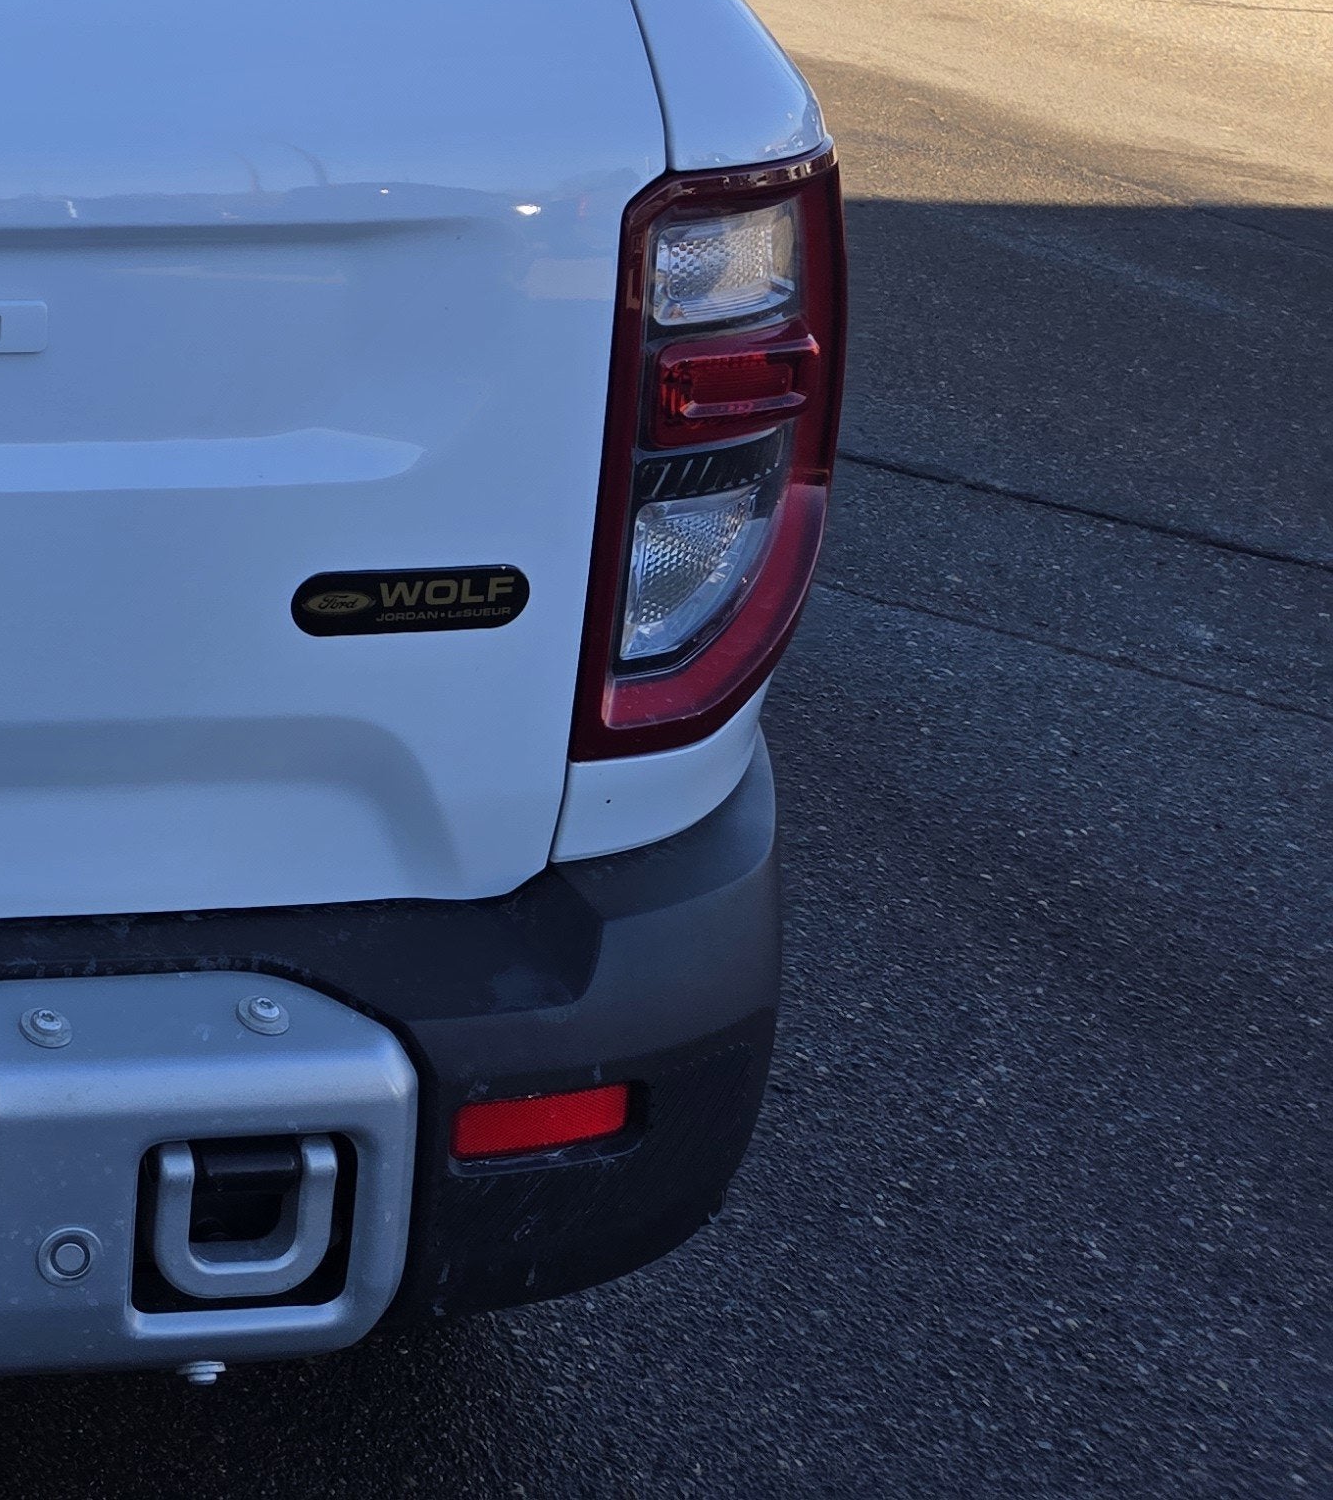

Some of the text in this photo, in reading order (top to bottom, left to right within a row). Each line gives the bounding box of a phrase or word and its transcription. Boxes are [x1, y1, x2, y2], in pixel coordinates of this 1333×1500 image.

[379, 576, 515, 608] WOLF
[317, 593, 360, 612] Ford
[375, 609, 439, 622] JORDAN
